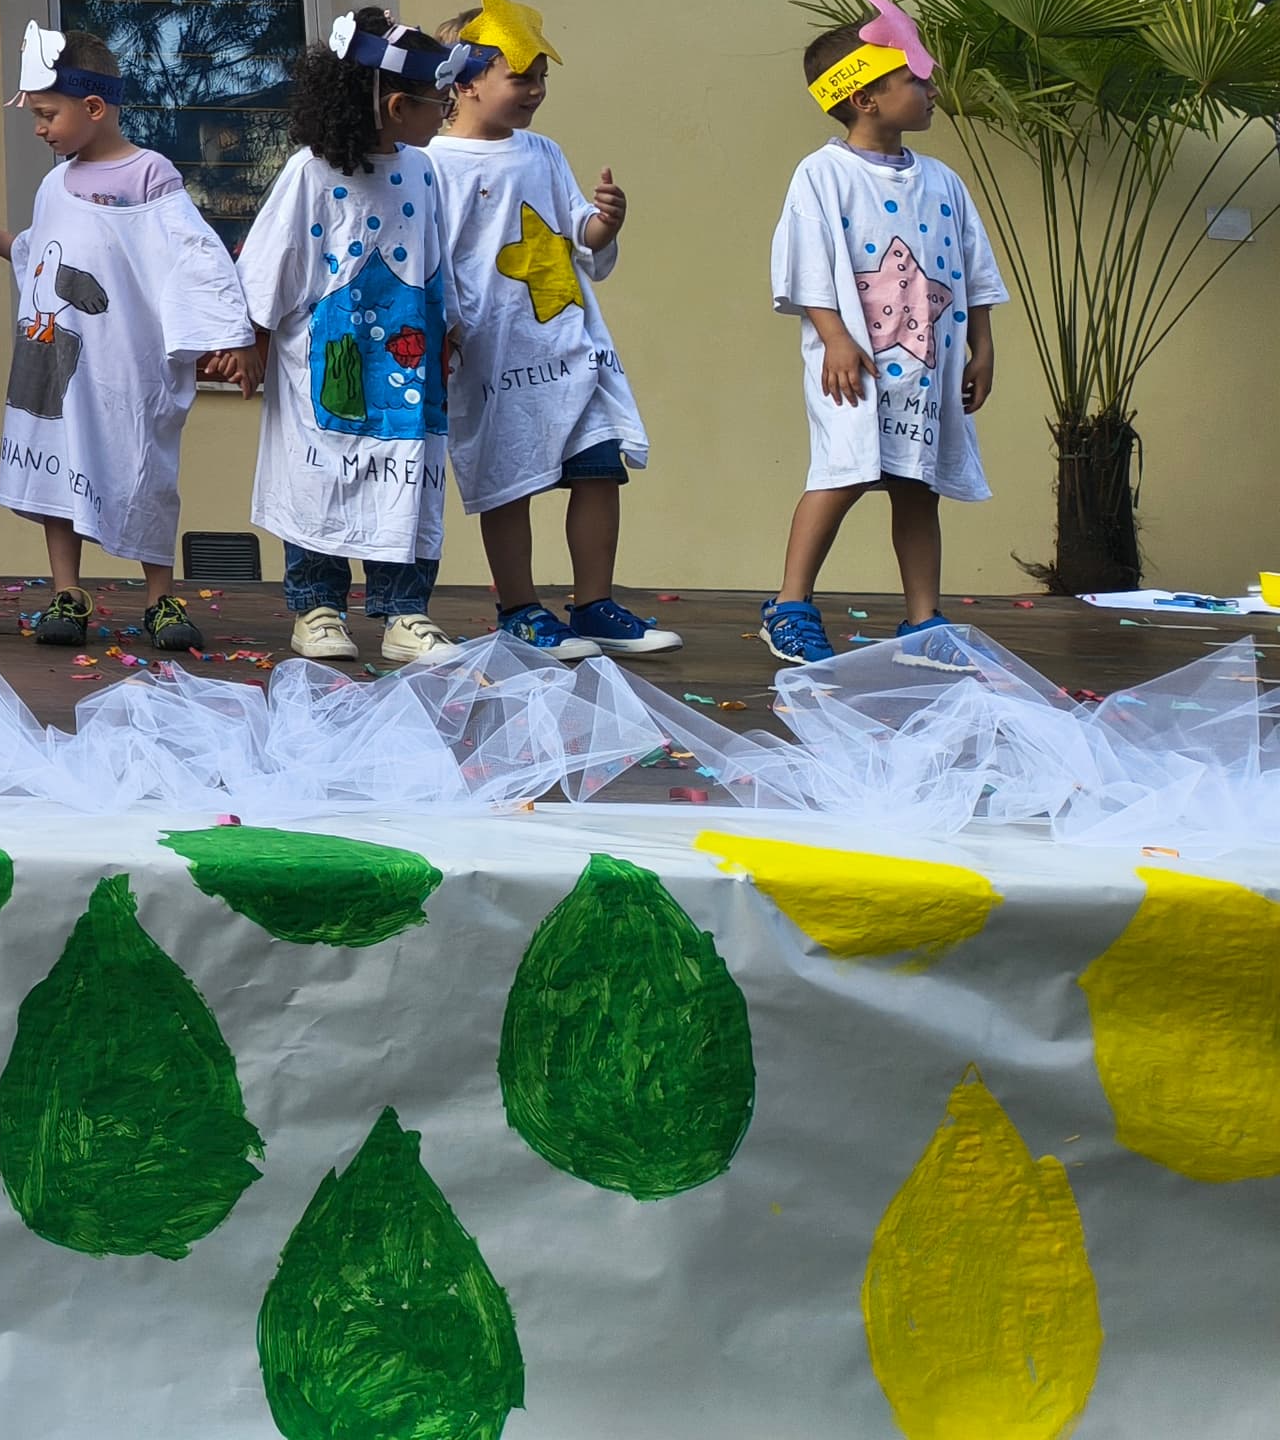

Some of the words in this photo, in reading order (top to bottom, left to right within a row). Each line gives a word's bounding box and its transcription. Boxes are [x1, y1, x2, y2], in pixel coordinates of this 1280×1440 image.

[816, 86, 830, 99] LA
[828, 58, 872, 88] STELLA
[500, 360, 572, 391] STELLA
[879, 417, 934, 446] ENZO
[0, 436, 60, 475] BIANO
[306, 445, 324, 468] IL
